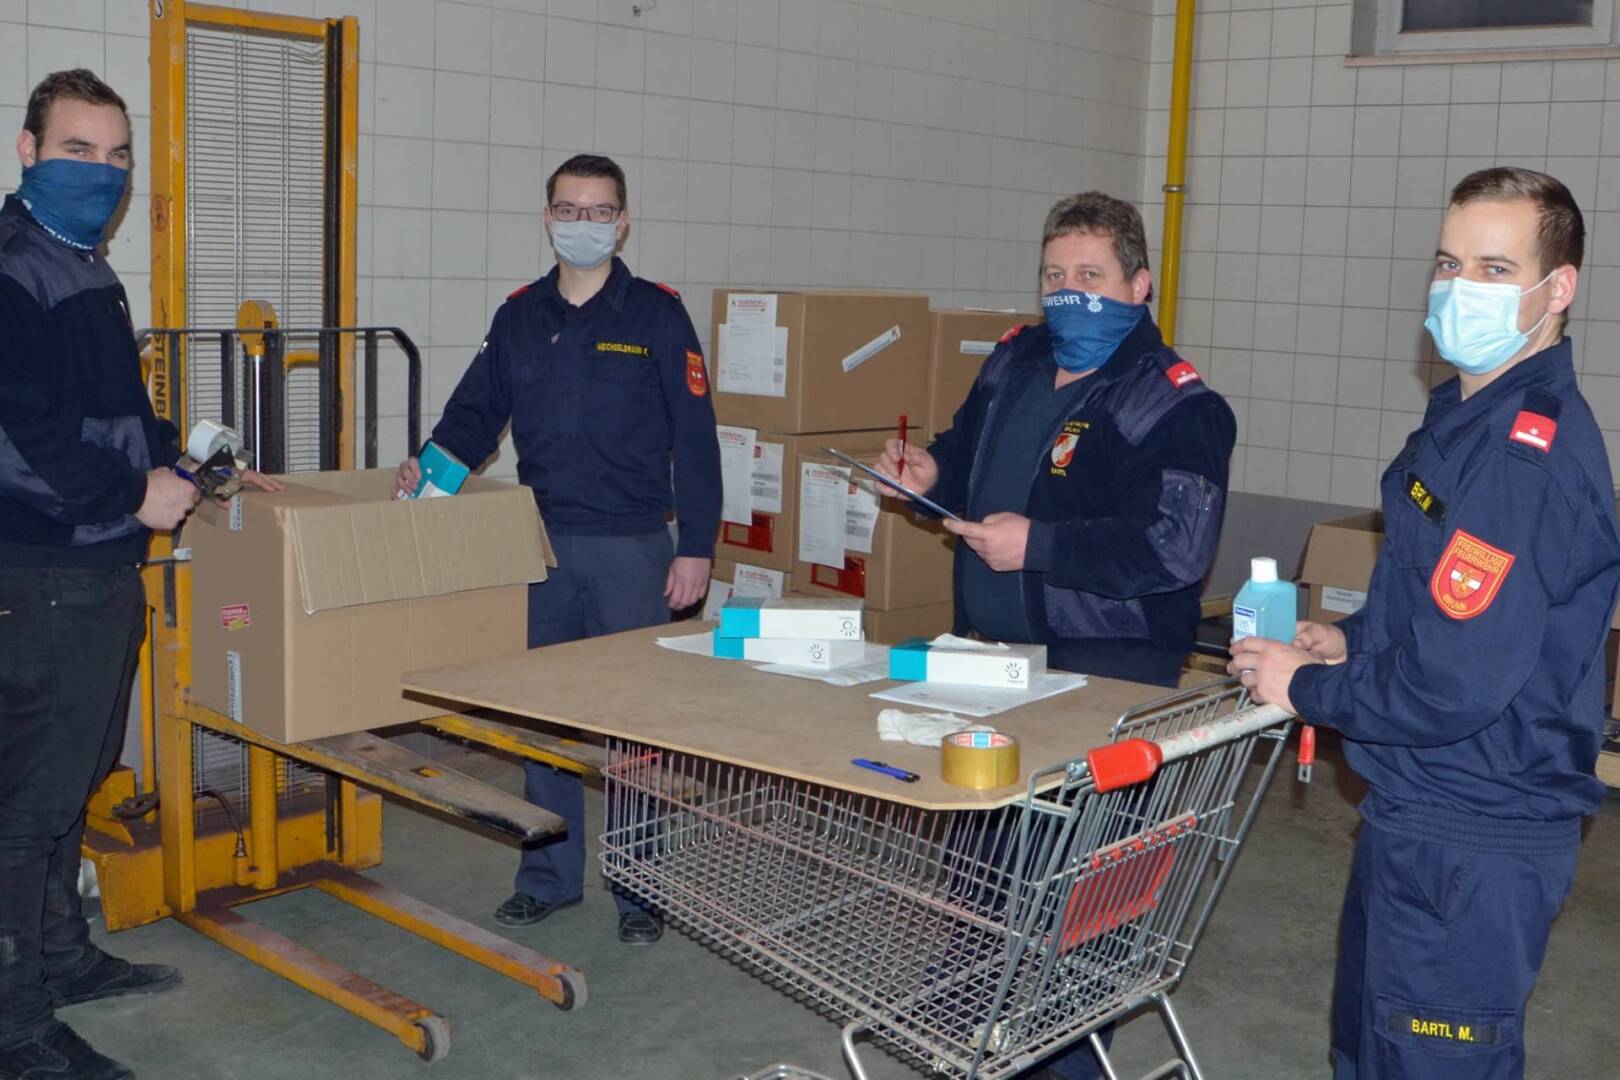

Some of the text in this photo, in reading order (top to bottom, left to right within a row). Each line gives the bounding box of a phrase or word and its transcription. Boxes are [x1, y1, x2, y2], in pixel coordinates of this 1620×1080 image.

[1453, 546, 1501, 574] FEUERWEHR
[1412, 1019, 1474, 1041] BARTL M.
